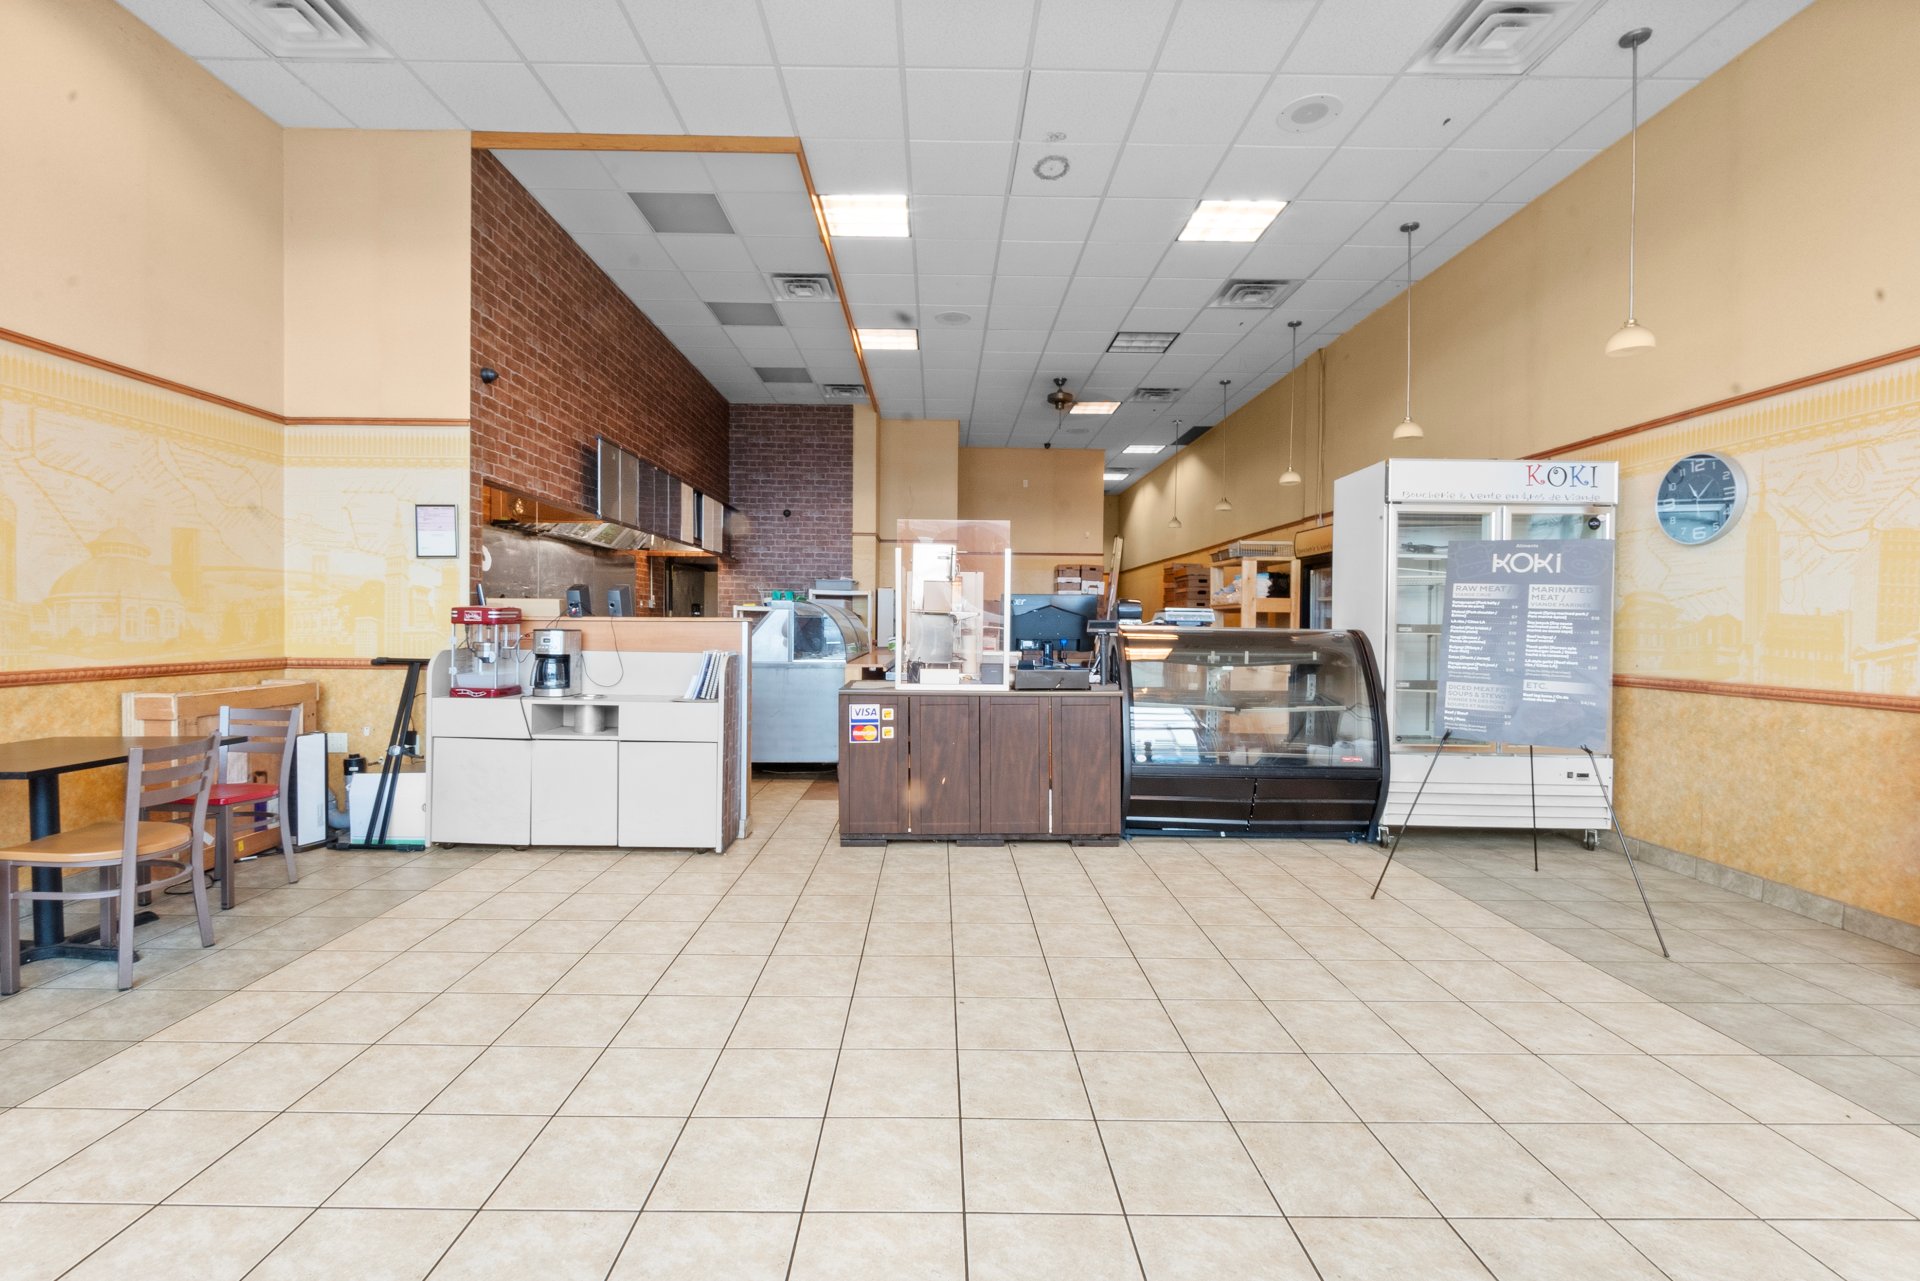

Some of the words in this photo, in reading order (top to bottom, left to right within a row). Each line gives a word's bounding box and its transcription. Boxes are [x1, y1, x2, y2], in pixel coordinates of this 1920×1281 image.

[1690, 459, 1705, 472] 12
[1525, 463, 1599, 488] KOKI
[1680, 468, 1686, 477] 11
[1722, 471, 1730, 480] 2
[1668, 482, 1677, 491] 10
[1669, 516, 1676, 525] 8
[1680, 527, 1687, 535] 7
[1713, 522, 1720, 531] 5
[1692, 526, 1706, 540] 6
[1479, 585, 1506, 593] MEAT
[854, 708, 877, 716] VISA
